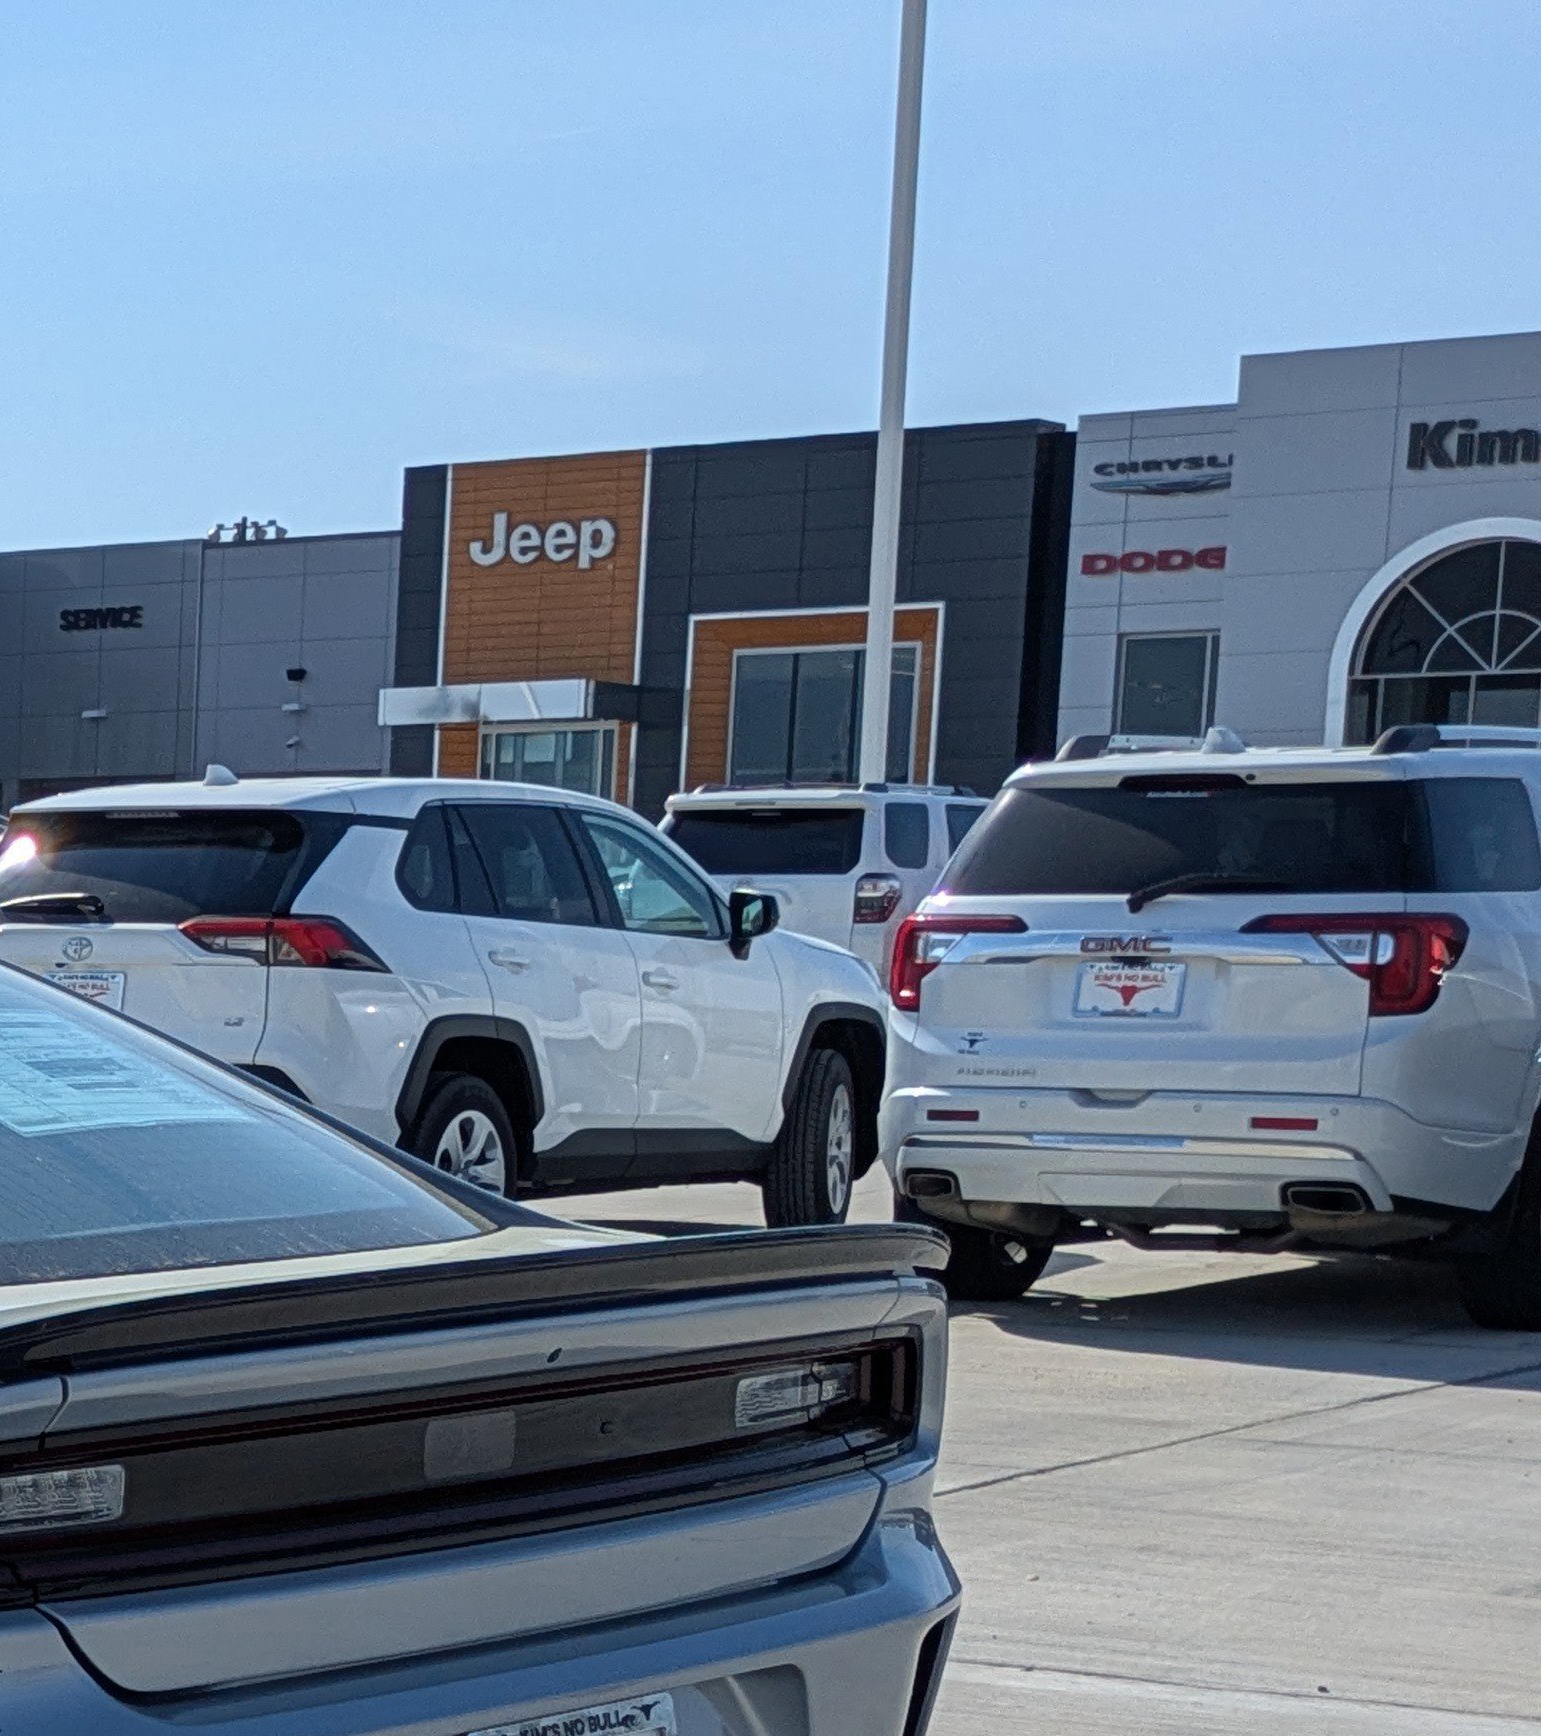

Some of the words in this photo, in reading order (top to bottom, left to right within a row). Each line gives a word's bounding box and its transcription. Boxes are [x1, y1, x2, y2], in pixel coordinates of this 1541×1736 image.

[1406, 418, 1541, 470] Kim
[1093, 453, 1233, 476] CHRYSL
[468, 510, 616, 569] Jeep
[1080, 546, 1227, 576] DODG
[60, 605, 144, 631] SERVICE
[1080, 936, 1173, 953] GMC
[588, 1709, 623, 1733] BULL
